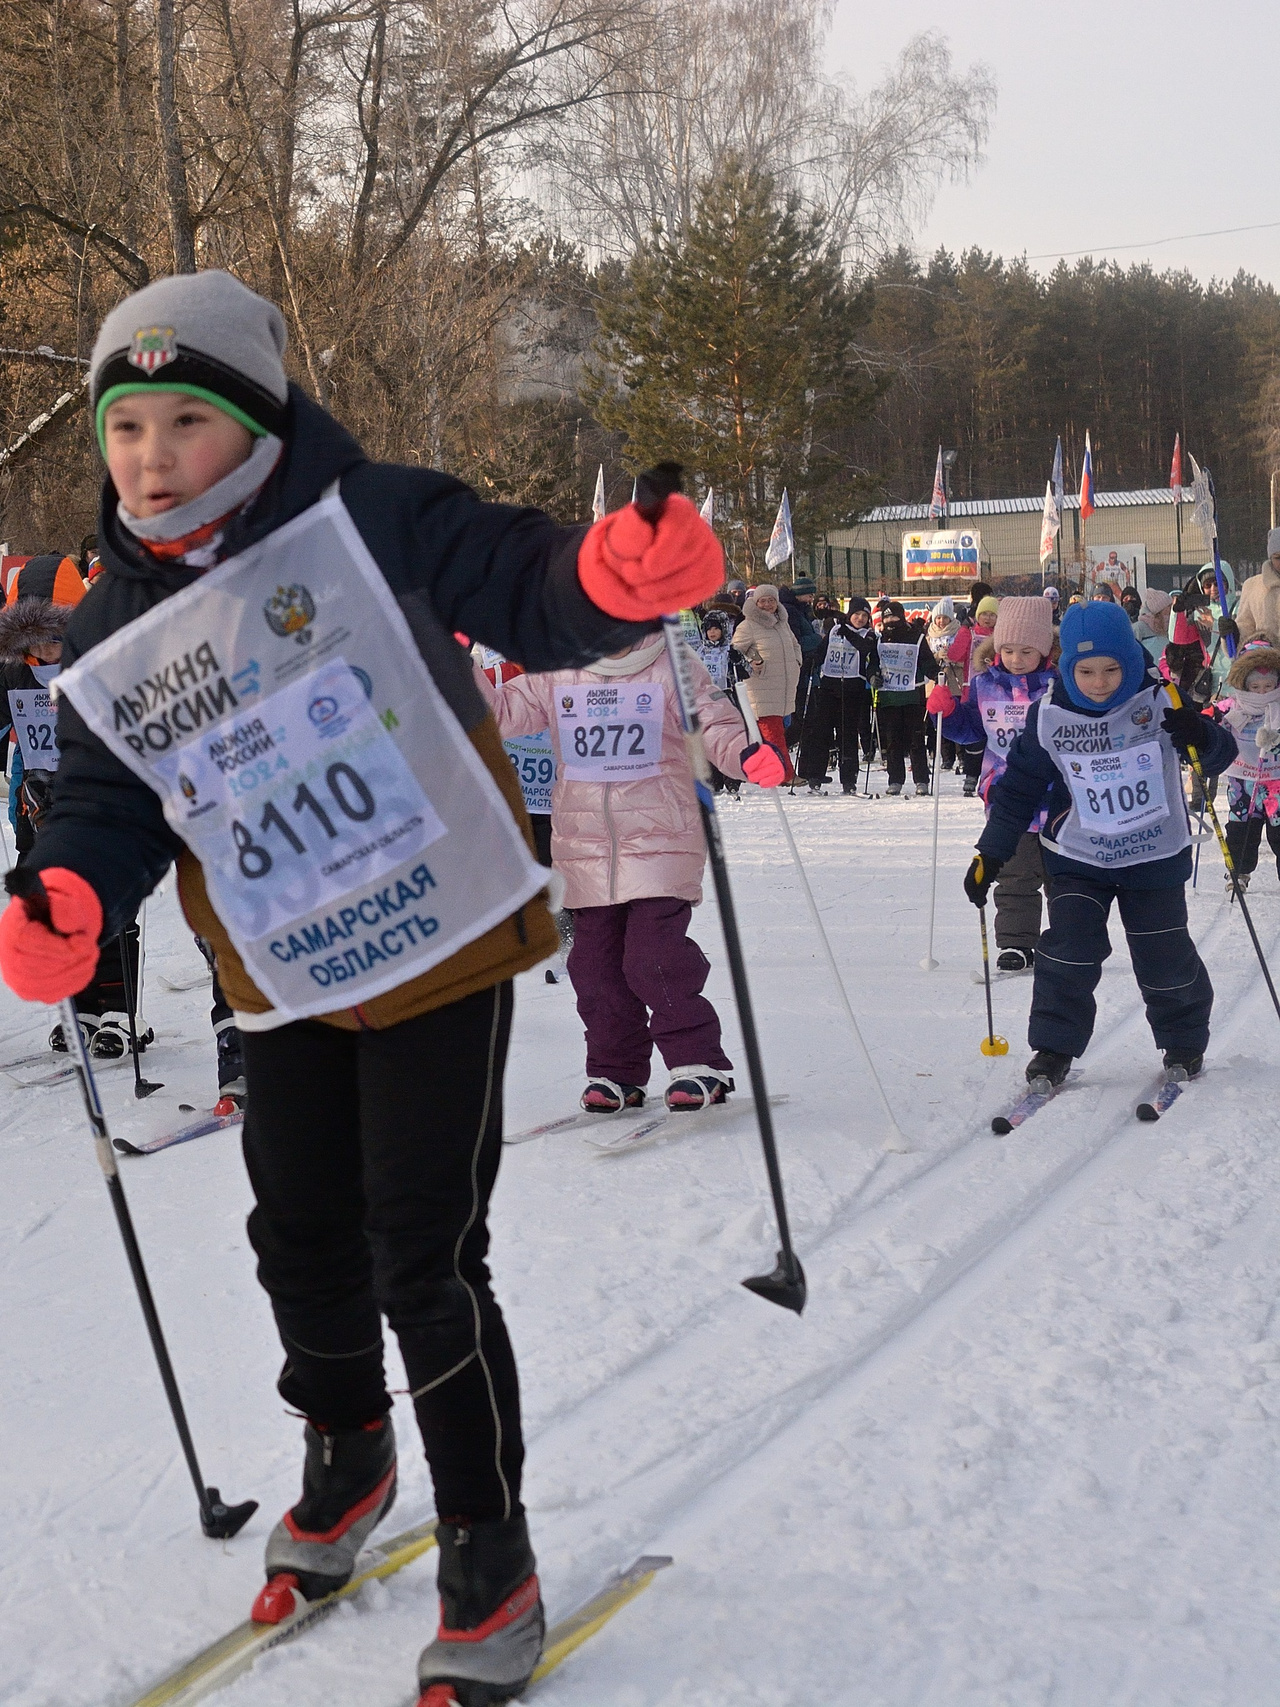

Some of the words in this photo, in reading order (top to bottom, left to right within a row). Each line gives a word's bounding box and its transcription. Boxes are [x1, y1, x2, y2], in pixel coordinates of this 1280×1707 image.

[112, 640, 220, 732] ЛЫЖНЯ
[885, 671, 910, 686] 716
[586, 689, 618, 698] ЛЫЖНЯ
[587, 697, 618, 706] РОССИИ
[35, 708, 55, 717] 202
[125, 676, 239, 758] РОССИИ
[587, 707, 618, 717] 2024
[27, 724, 58, 750] 82
[209, 718, 267, 761] ЛЫЖНЯ
[574, 723, 645, 757] 8272
[1051, 722, 1109, 738] ЛЫЖНЯ
[217, 734, 276, 774] РОССИИ
[1053, 736, 1112, 753] РОССИИ
[1090, 756, 1121, 766] ЛЫЖНЯ
[1091, 763, 1122, 773] РОССИИ
[1093, 772, 1126, 782] 2024
[524, 797, 552, 808] ЛАСТЬ
[1086, 780, 1150, 814] 8108
[231, 761, 376, 880] 8110
[1117, 813, 1145, 826] САМАРСКАЯ
[1144, 805, 1163, 817] ОБЛАСТЬ
[1089, 825, 1163, 850] САМАРСКАЯ
[1095, 843, 1156, 863] ОБЛАСТЬ
[270, 863, 438, 963] САМАРСКАЯ
[309, 914, 440, 987] ОБЛАСТЬ
